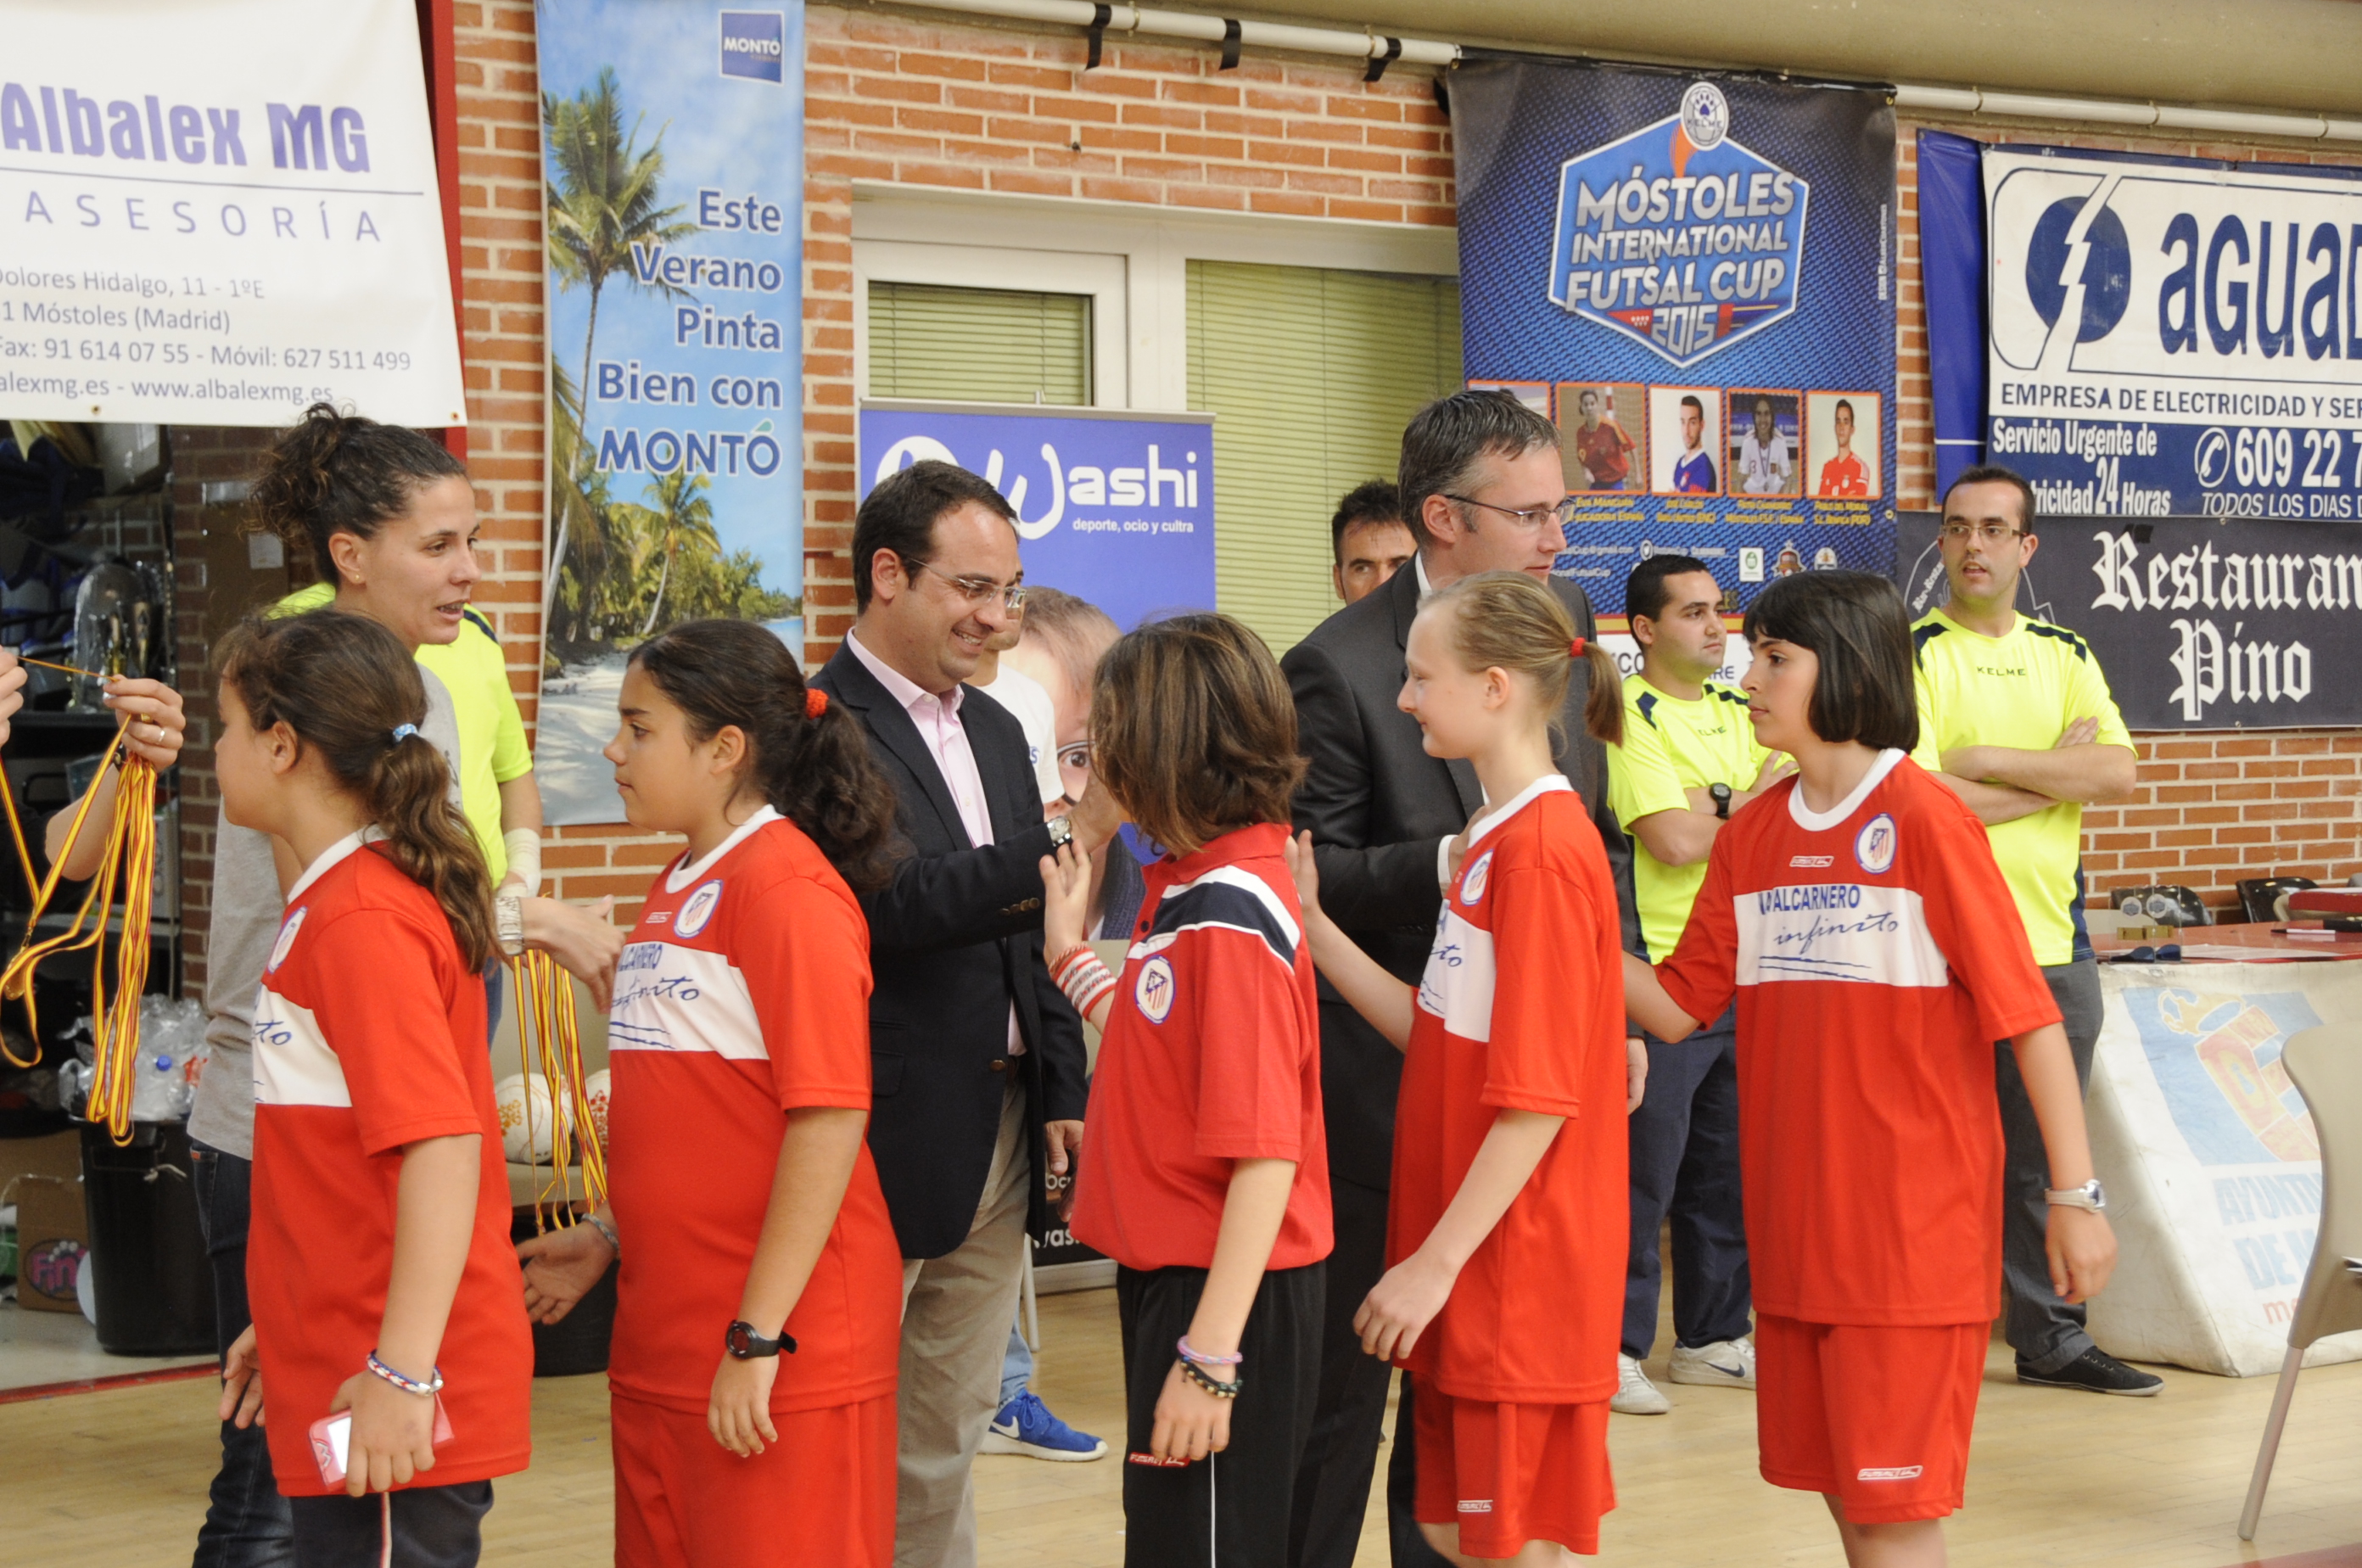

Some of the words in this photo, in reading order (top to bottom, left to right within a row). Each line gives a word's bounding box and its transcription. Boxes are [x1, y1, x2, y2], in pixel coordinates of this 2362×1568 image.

[724, 36, 781, 56] MONTÓ
[1, 82, 248, 166] Albalex
[266, 103, 371, 173] MG
[25, 190, 381, 243] ASESORÍA
[700, 190, 781, 232] Este
[1576, 165, 1795, 232] MÓSTOLES
[1571, 220, 1788, 265] INTERNATIONAL
[0, 267, 76, 290] olores
[82, 271, 174, 299] Hidalgo,
[182, 276, 207, 297] 11
[630, 243, 781, 292] Verano
[1565, 261, 1703, 311] FUTSAL
[1710, 258, 1785, 300] CUP
[23, 300, 127, 327] Móstoles
[135, 305, 230, 336] (Madrid)
[676, 306, 781, 351] Pinta
[1651, 304, 1719, 357] 2015
[44, 338, 72, 360] 91
[80, 339, 121, 361] 614
[128, 341, 155, 362] 07
[163, 343, 189, 364] 55
[211, 344, 277, 367] Móvil:
[284, 348, 322, 368] 627
[329, 349, 366, 370] 511
[372, 351, 411, 371] 499
[132, 378, 333, 406] www.albalexmg.es
[596, 361, 696, 405] Bien
[709, 373, 781, 410] con
[2001, 383, 2113, 410] EMPRESA
[2119, 389, 2147, 412] DE
[2153, 390, 2306, 417] ELECTRICIDAD
[2311, 396, 2325, 418] Y
[596, 419, 781, 476] MONTÓ
[1993, 417, 2062, 455] Servicio
[2064, 420, 2133, 463] Urgente
[2135, 423, 2158, 457] de
[2235, 427, 2293, 488] 609
[2301, 428, 2342, 488] 22
[2096, 456, 2119, 515] 24
[2122, 481, 2172, 516] Horas
[2202, 492, 2264, 517] TODOS
[2269, 494, 2304, 518] LOS
[2309, 494, 2352, 518] DIAS
[1072, 518, 1121, 534] deporte,
[1123, 519, 1149, 532] ocio
[1151, 522, 1160, 535] y
[1161, 519, 1195, 533] cultra
[2091, 530, 2362, 612] Restauran
[1977, 665, 2026, 676] KELME
[2169, 619, 2311, 721] Pino
